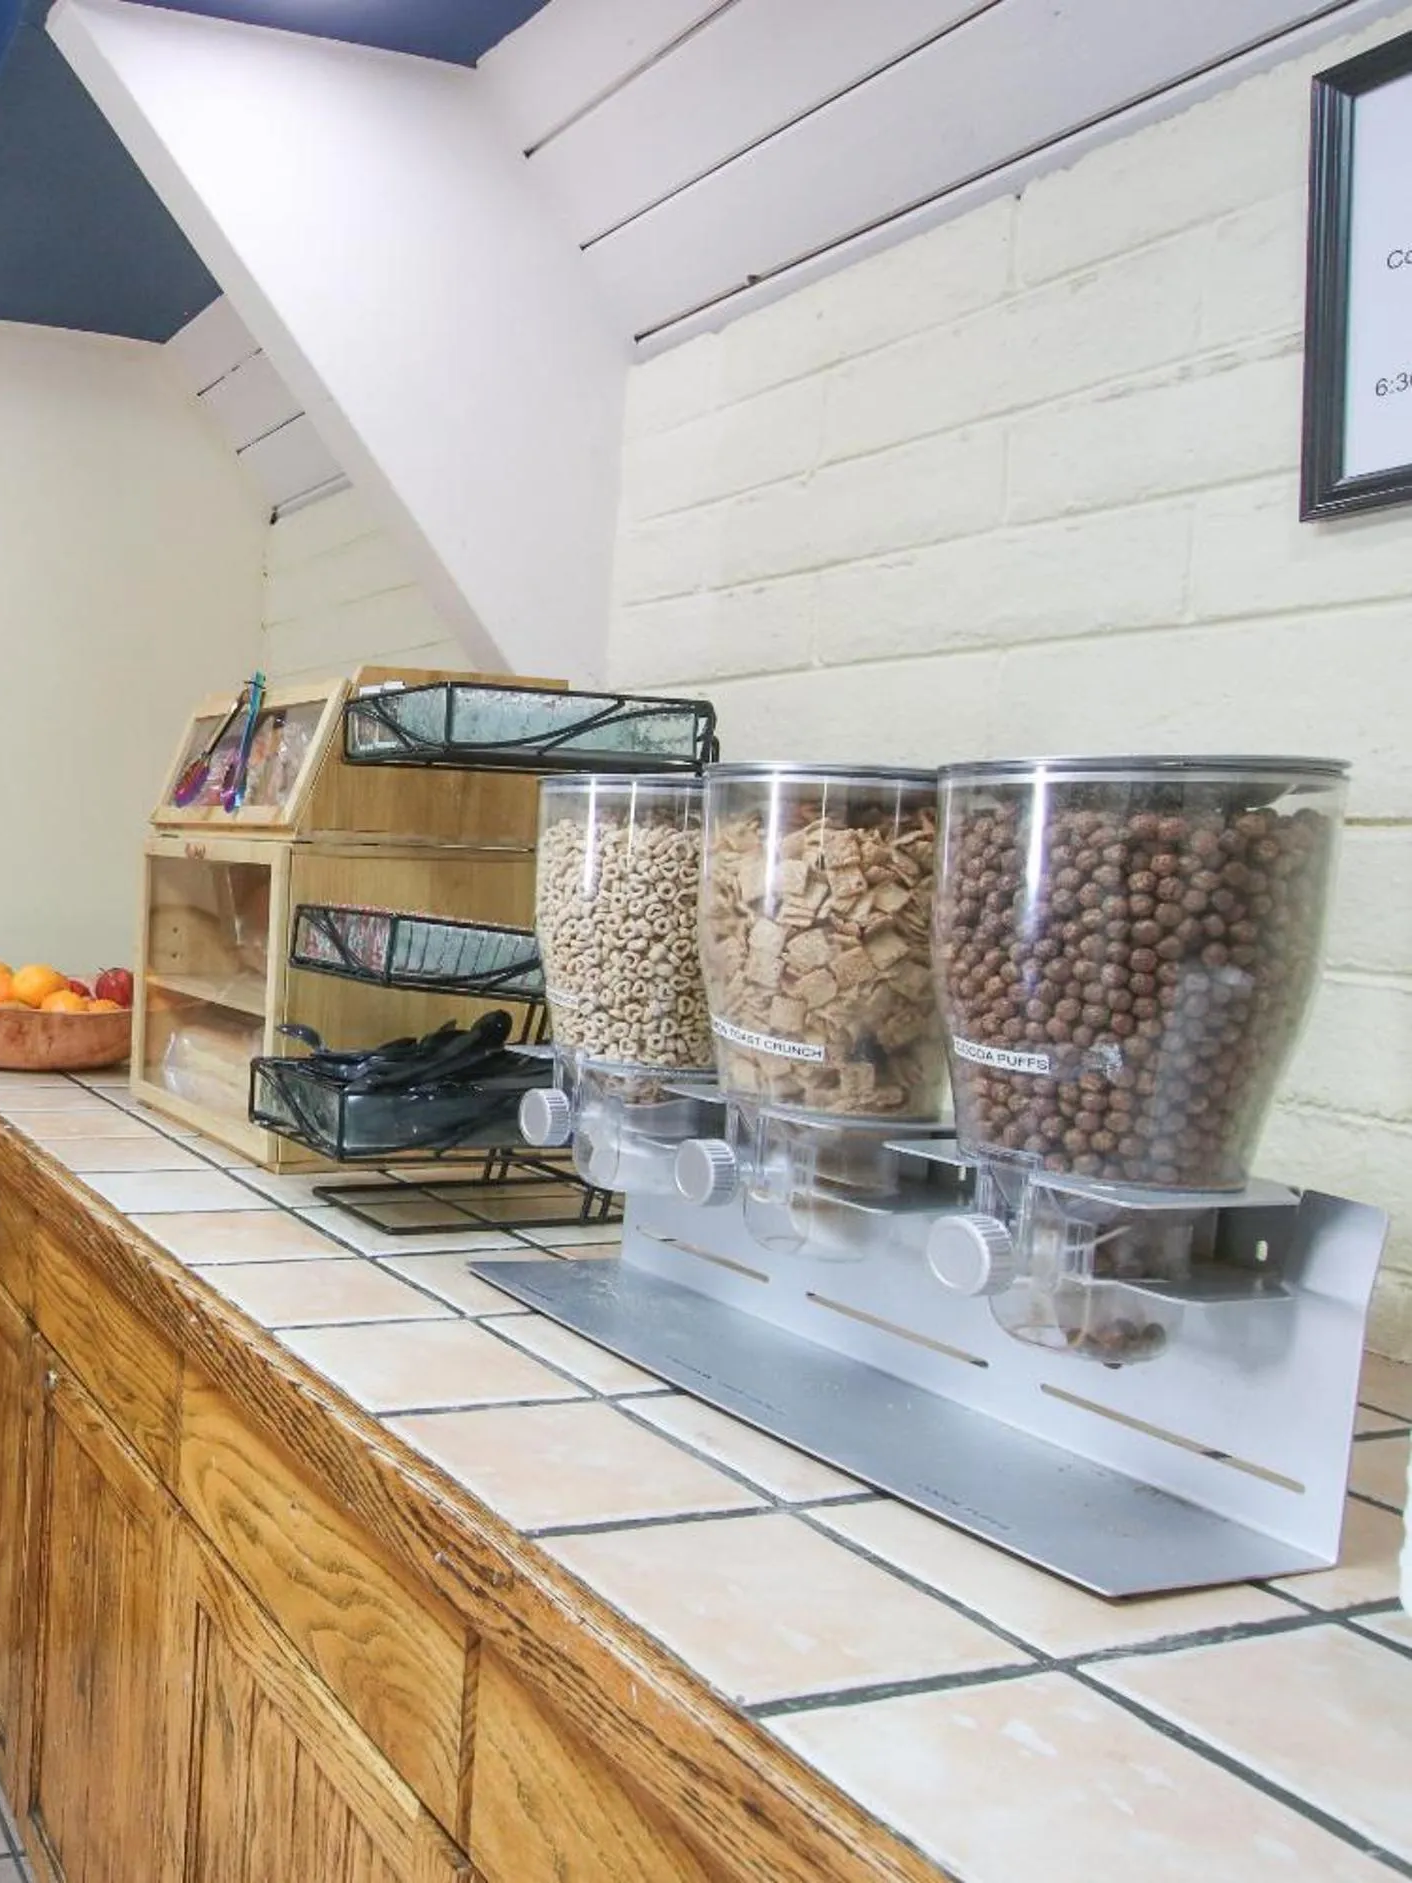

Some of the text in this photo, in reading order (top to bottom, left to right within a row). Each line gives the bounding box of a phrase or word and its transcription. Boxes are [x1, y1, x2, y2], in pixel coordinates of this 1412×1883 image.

[1375, 373, 1412, 397] 6:3
[730, 1028, 760, 1045] TOAST
[763, 1040, 822, 1058] CRUNCH
[956, 1040, 1049, 1071] COCOA PUFFS
